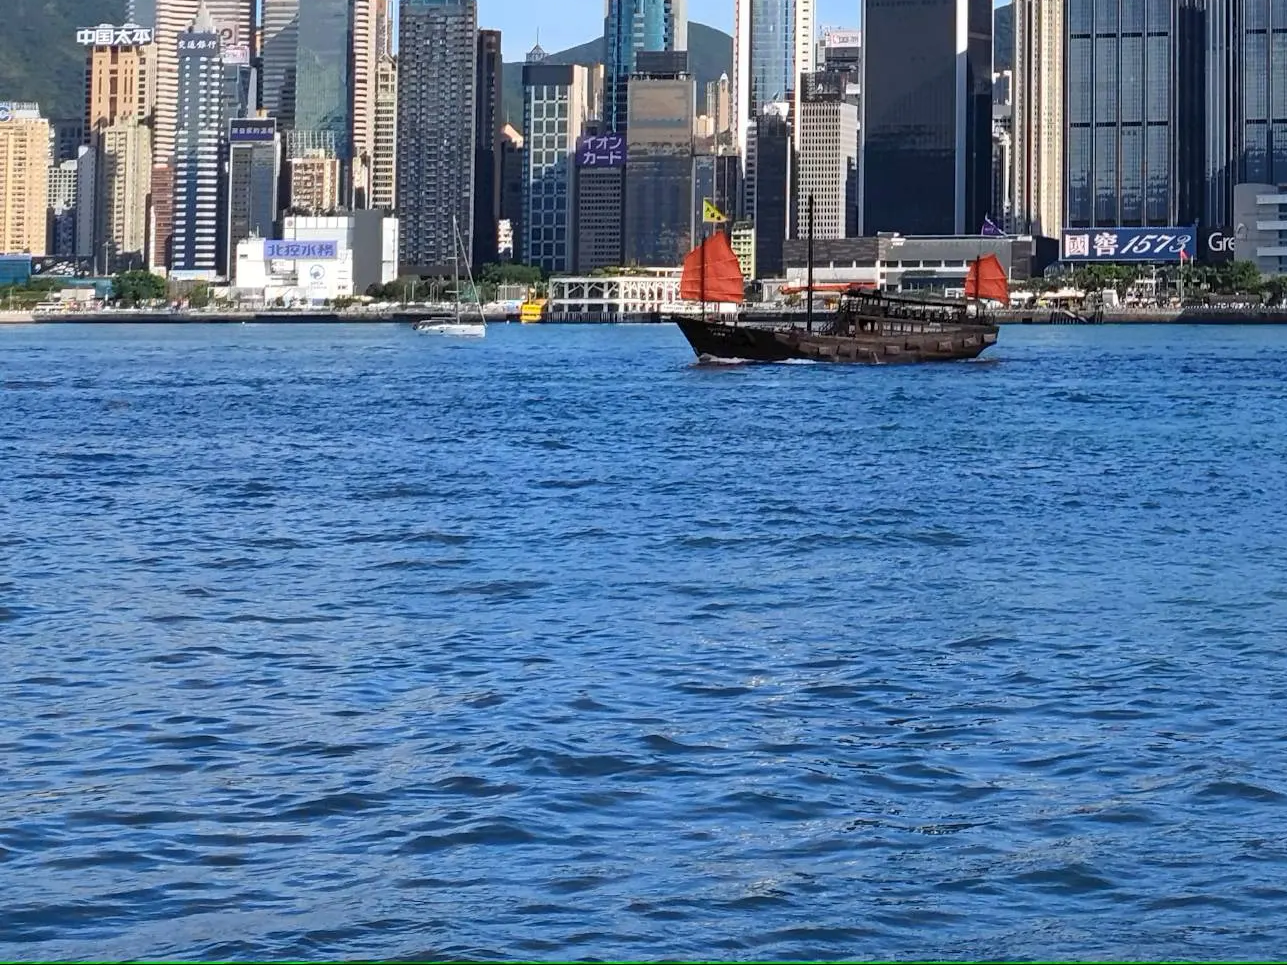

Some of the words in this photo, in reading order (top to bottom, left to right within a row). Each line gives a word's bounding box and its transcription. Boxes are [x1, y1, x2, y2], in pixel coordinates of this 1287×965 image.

[76, 28, 151, 46] 中国太平
[583, 136, 622, 150] イオン
[583, 151, 622, 165] カード
[1065, 232, 1119, 258] 國窖
[1120, 234, 1192, 254] 1573
